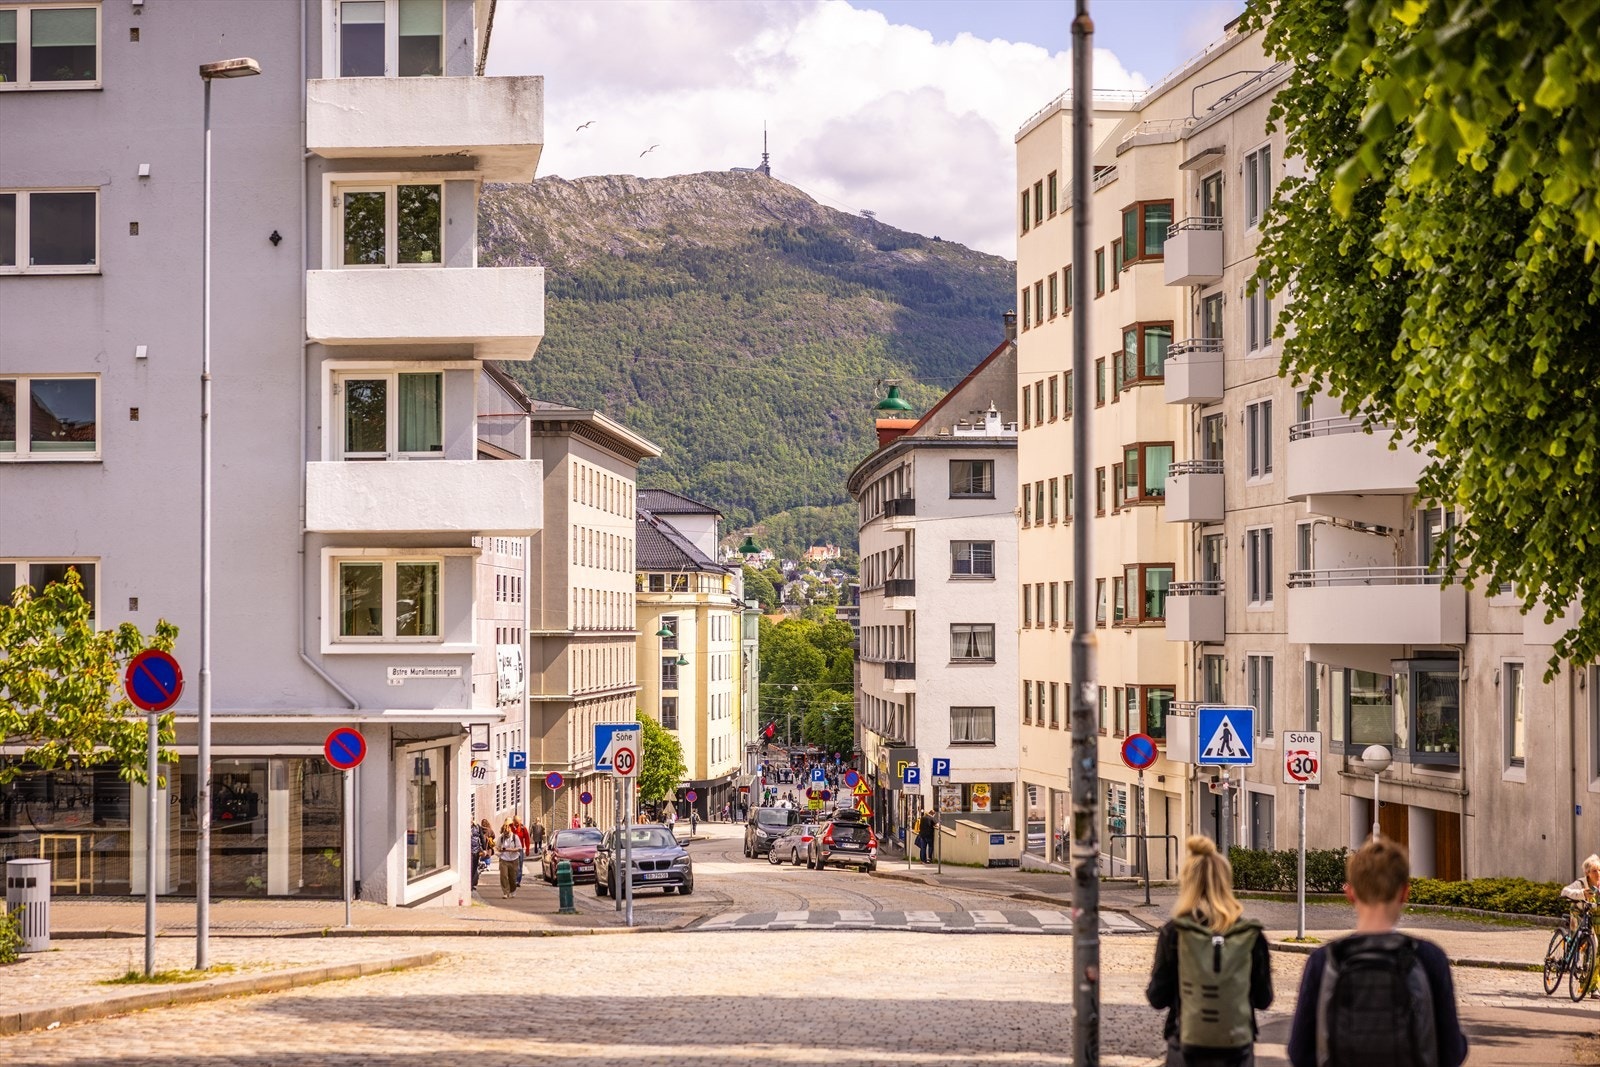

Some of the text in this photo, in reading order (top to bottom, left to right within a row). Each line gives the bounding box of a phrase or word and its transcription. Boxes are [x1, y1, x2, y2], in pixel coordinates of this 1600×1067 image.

[392, 668, 457, 677] Østre Murallmenningen
[616, 733, 633, 742] Sone
[1290, 733, 1315, 743] Sone
[513, 754, 523, 767] P
[617, 753, 632, 768] 30
[1292, 757, 1313, 774] 30
[937, 760, 947, 774] P
[814, 770, 822, 780] P
[907, 770, 917, 782] P
